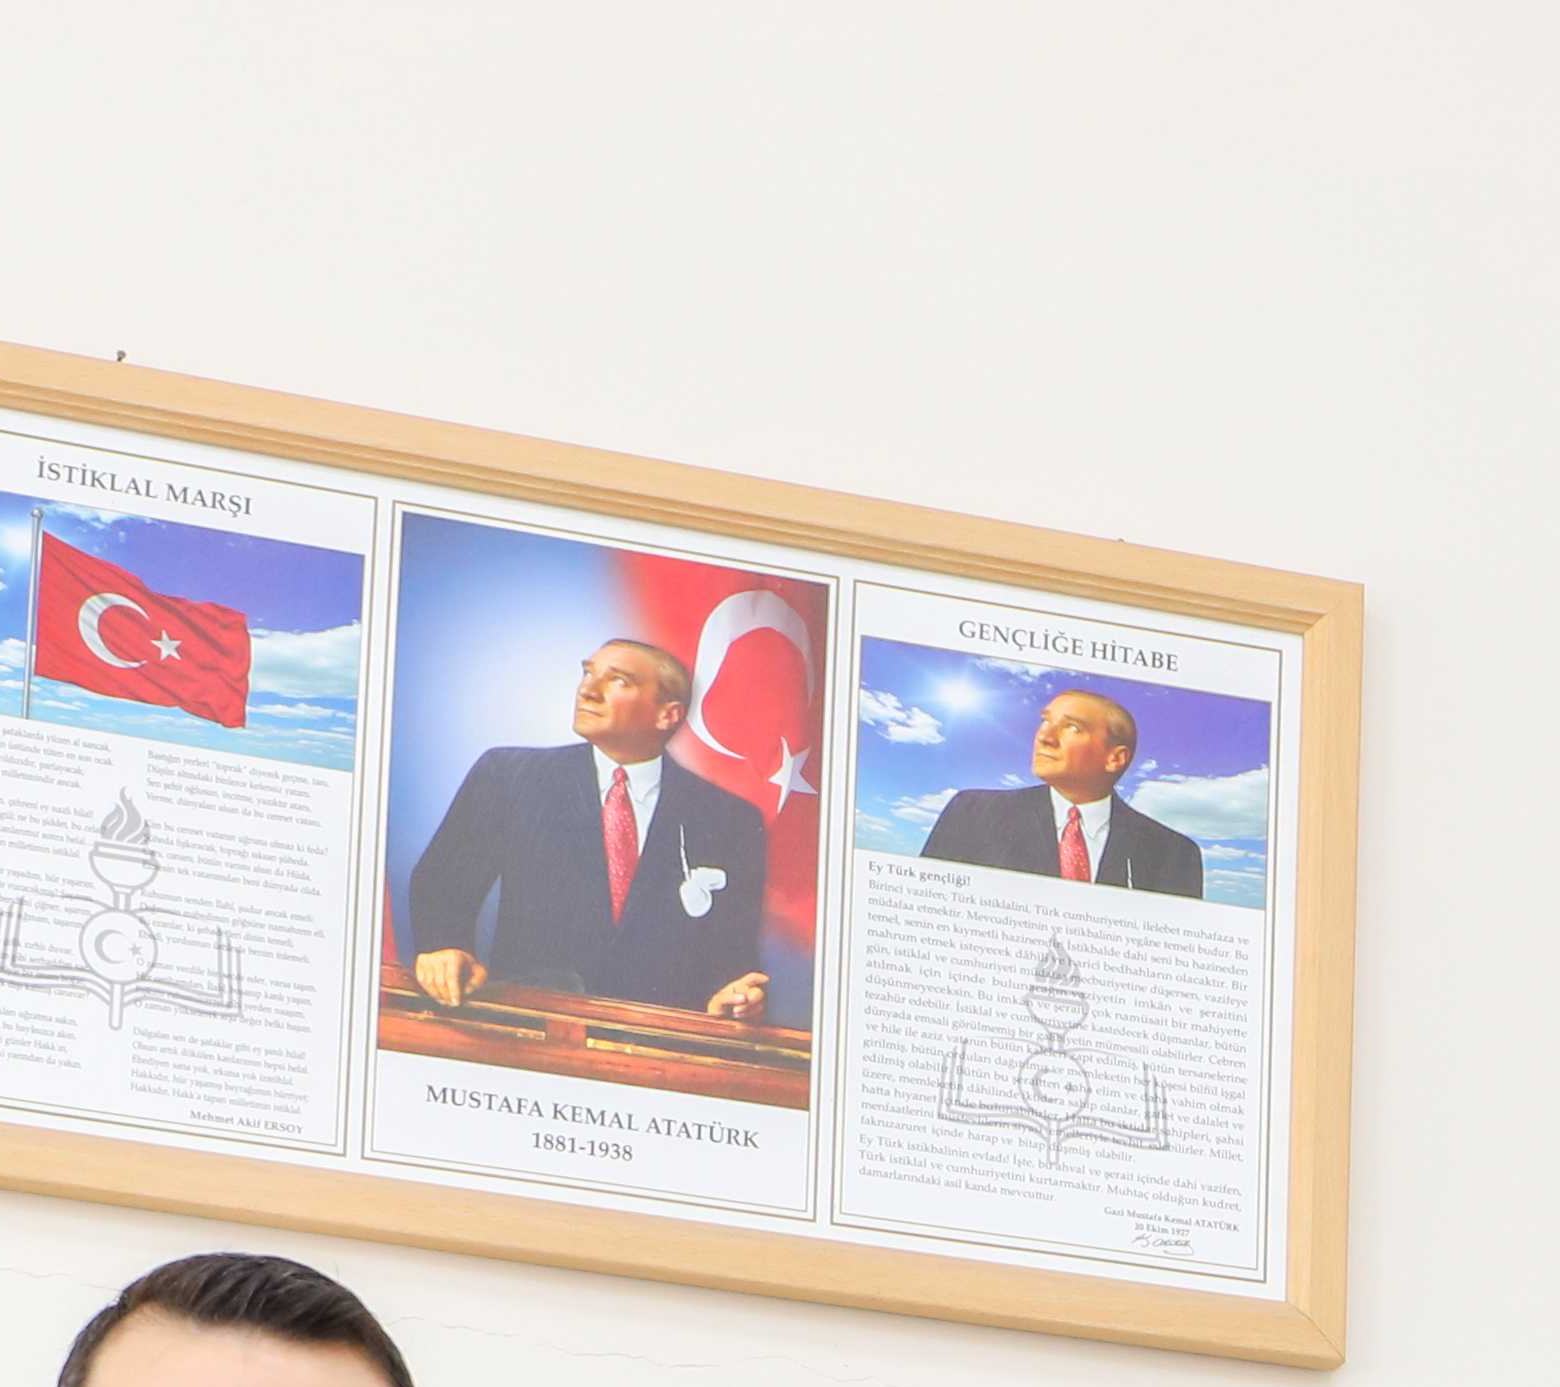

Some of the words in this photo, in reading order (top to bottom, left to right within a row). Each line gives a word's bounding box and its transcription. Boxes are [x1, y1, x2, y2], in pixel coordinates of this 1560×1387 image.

[36, 455, 159, 499] İSTİKLAL
[164, 482, 252, 518] MARŞI
[958, 618, 1084, 657] GENÇLİĞE
[1089, 639, 1178, 672] HİTABE
[868, 860, 884, 876] Ey
[886, 863, 916, 878] Türk
[919, 871, 971, 888] gençliği!
[189, 1109, 234, 1125] Mehmet
[236, 1116, 262, 1129] Akif
[263, 1119, 303, 1135] ERSOY
[425, 1084, 545, 1119] MUSTAFA
[551, 1102, 640, 1132] KEMAL
[645, 1115, 760, 1150] ATATÜRK
[530, 1130, 634, 1163] 1881-1938
